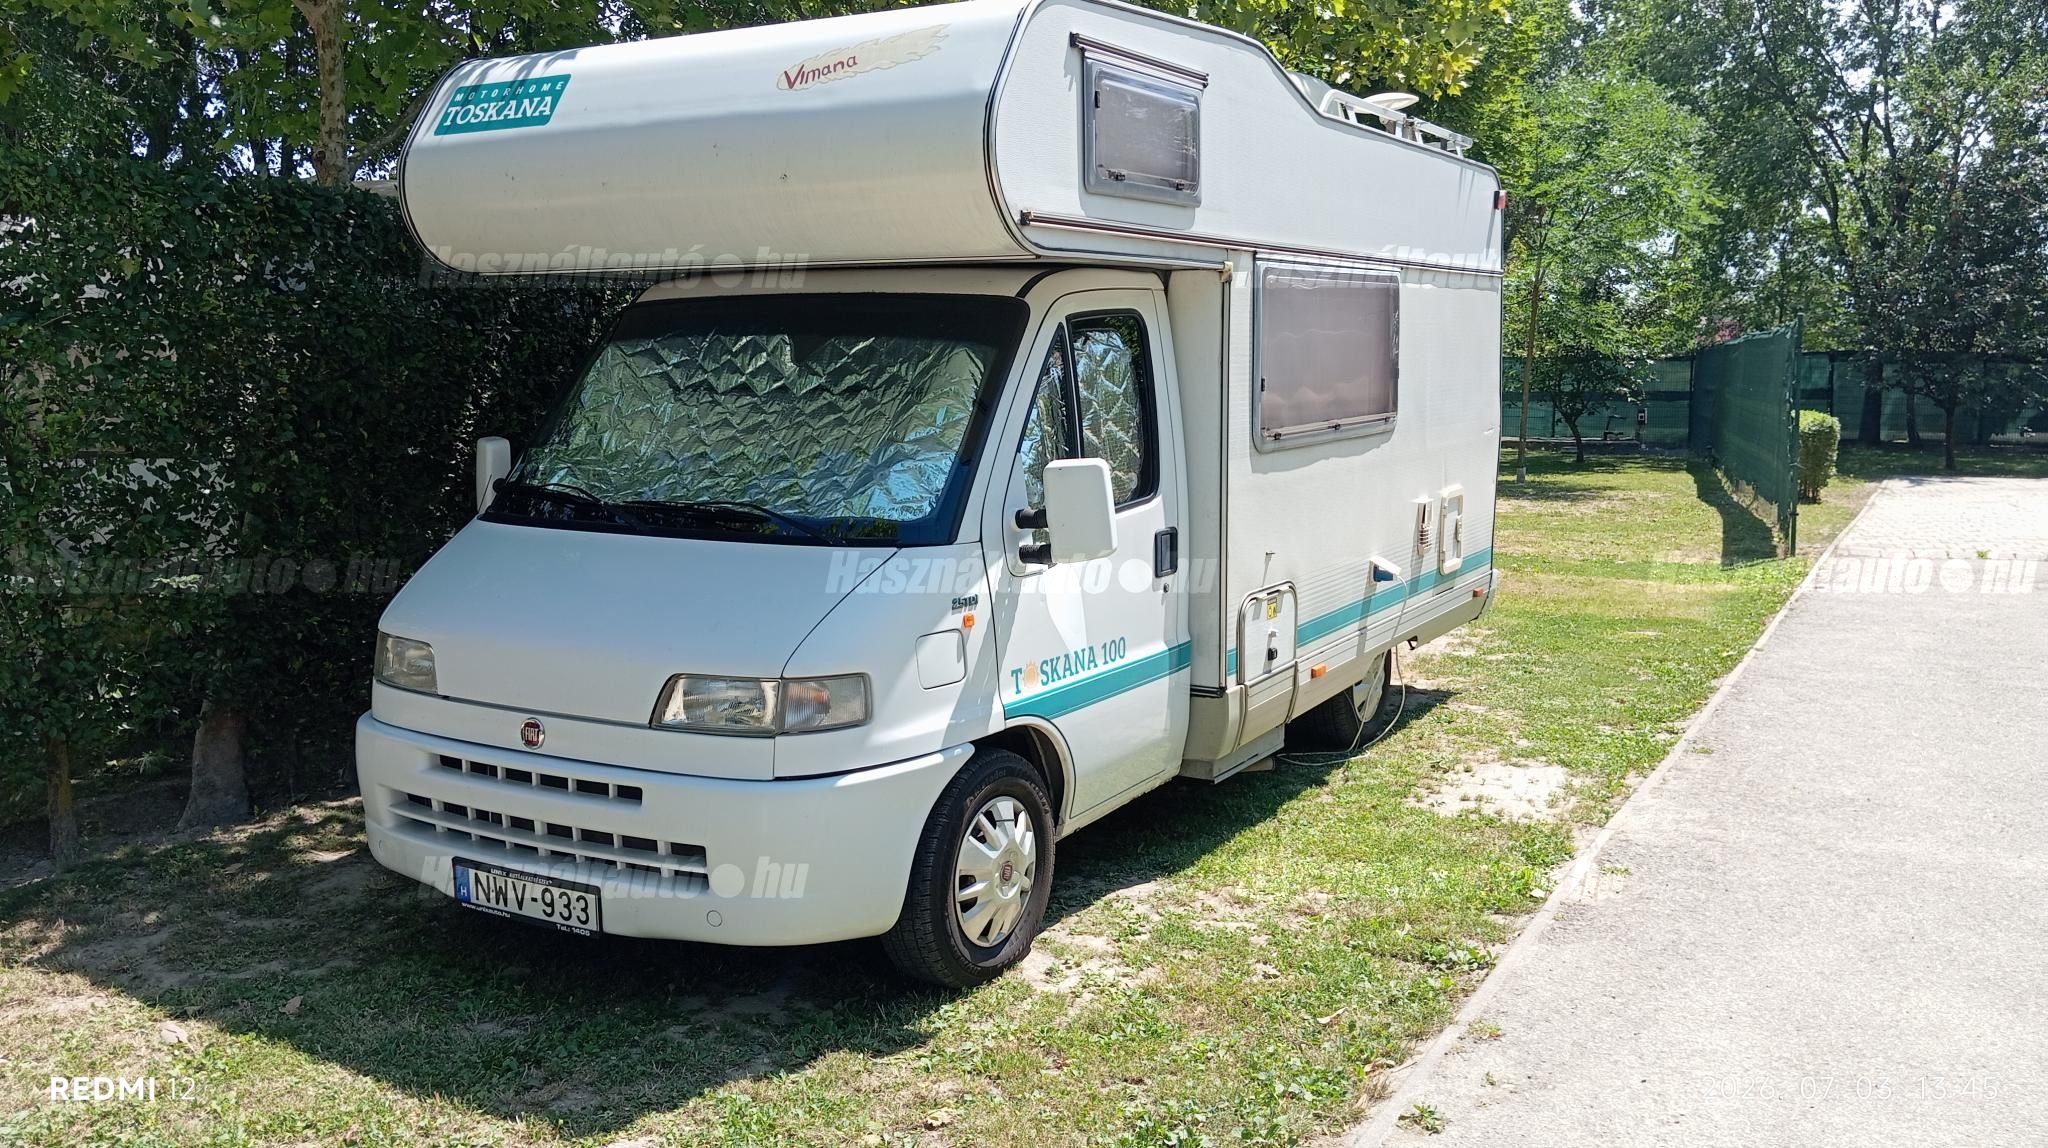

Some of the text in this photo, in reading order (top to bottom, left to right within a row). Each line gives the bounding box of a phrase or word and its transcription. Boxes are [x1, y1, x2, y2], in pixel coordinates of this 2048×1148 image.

[783, 55, 858, 89] Vimana
[454, 81, 564, 102] MOTORHOME
[443, 96, 552, 126] TOSKANA
[1101, 636, 1126, 665] 100
[525, 727, 539, 742] FIAT
[460, 886, 467, 896] H
[474, 872, 590, 925] NWV-933
